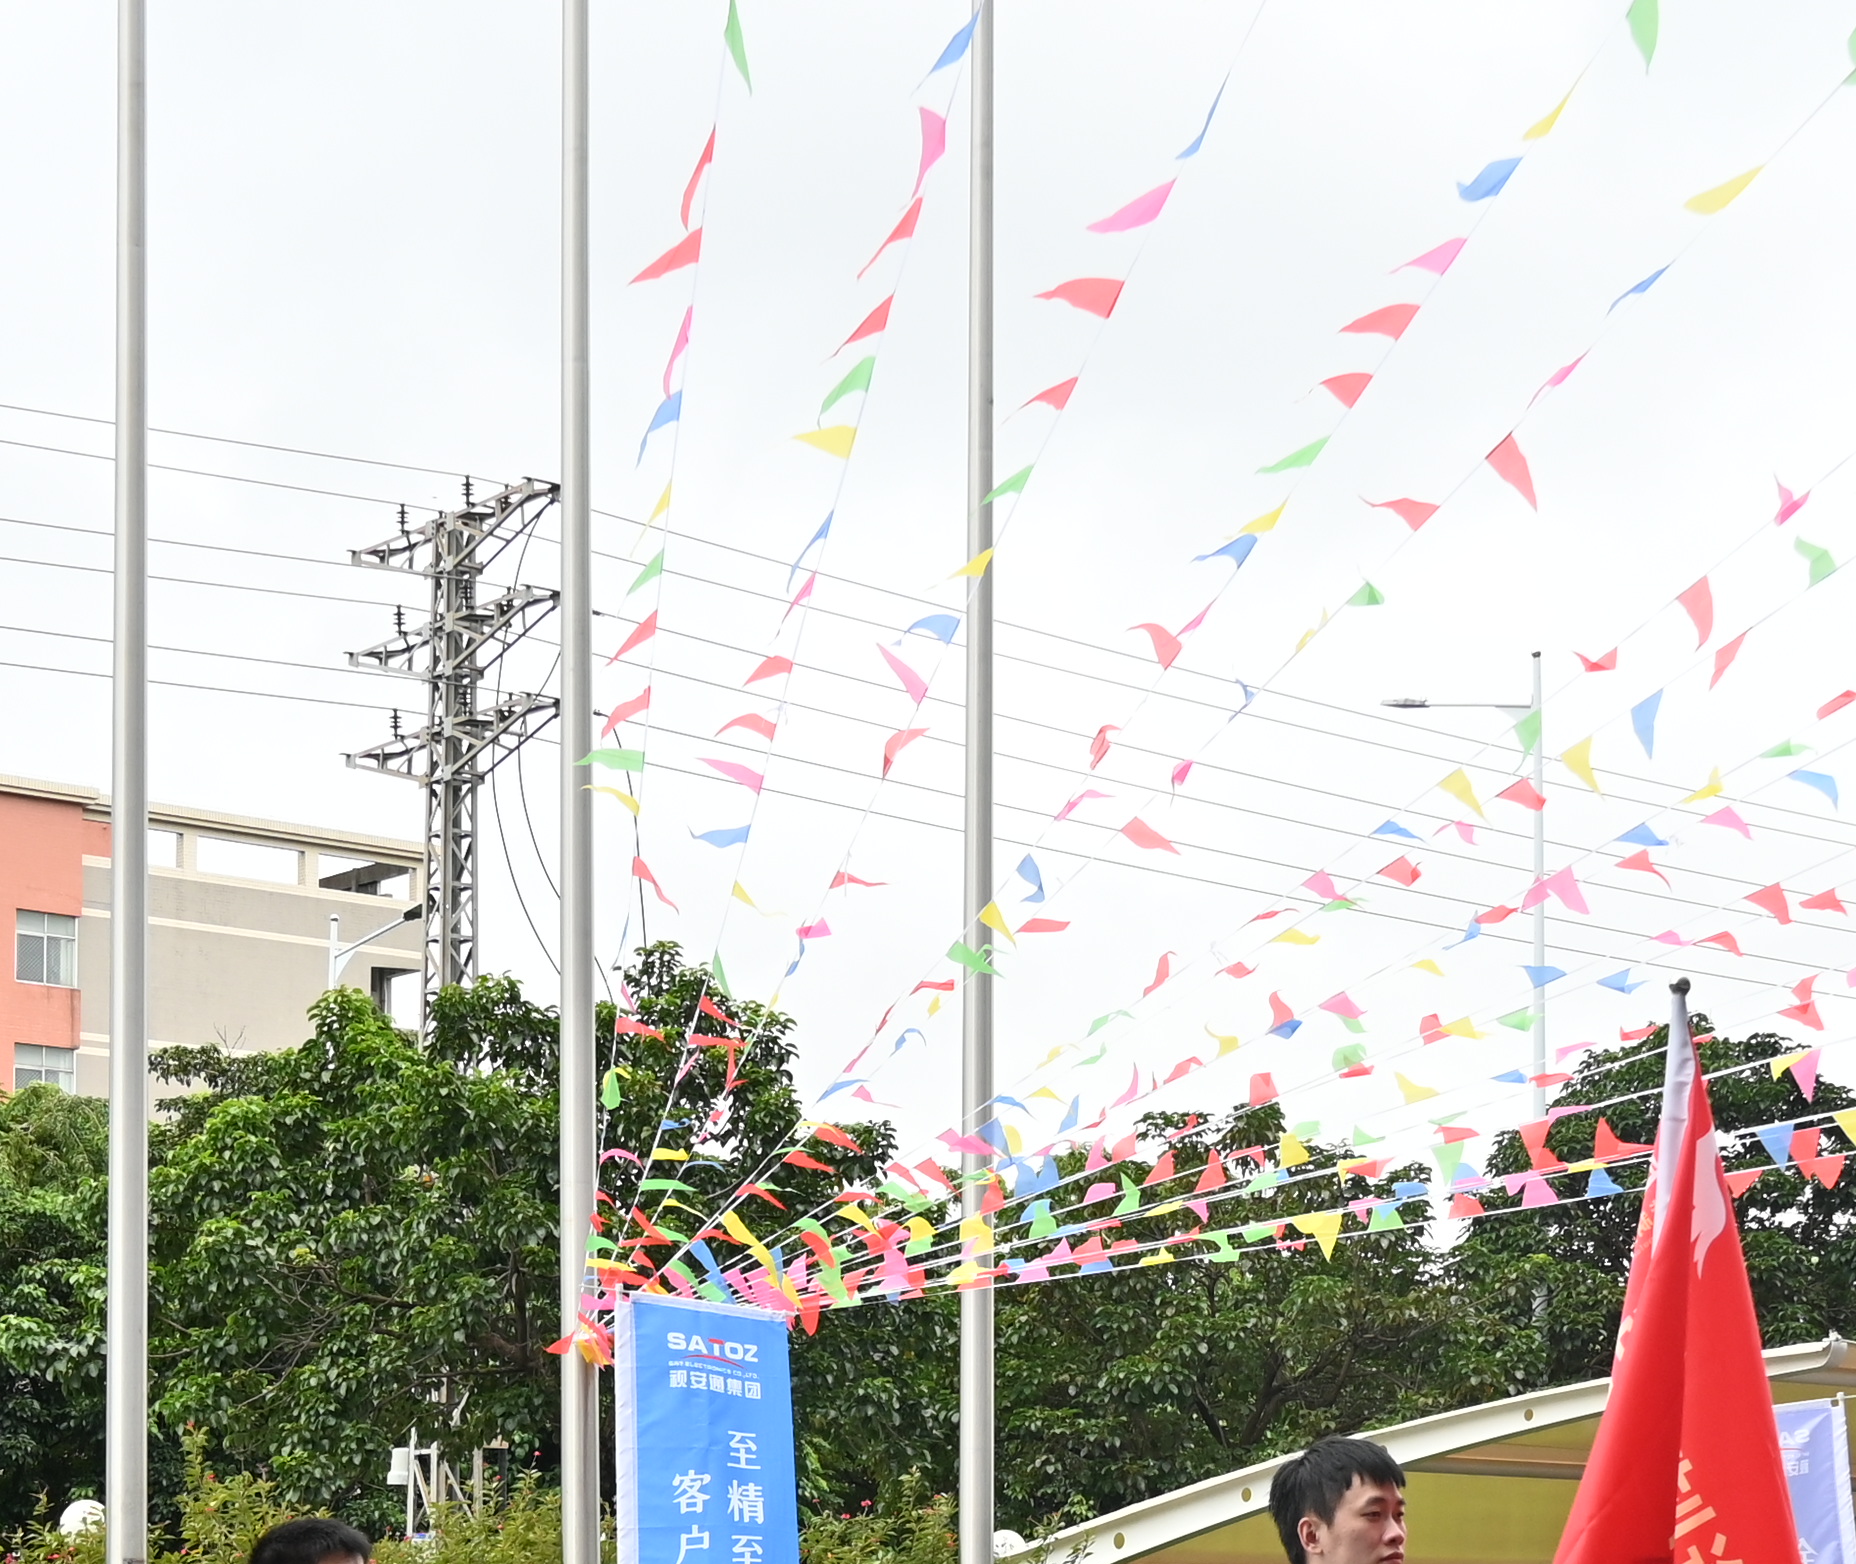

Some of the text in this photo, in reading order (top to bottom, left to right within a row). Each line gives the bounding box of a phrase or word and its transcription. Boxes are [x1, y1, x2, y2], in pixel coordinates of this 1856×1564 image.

[667, 1332, 759, 1363] SATOZ
[669, 1369, 762, 1399] 视安通集团
